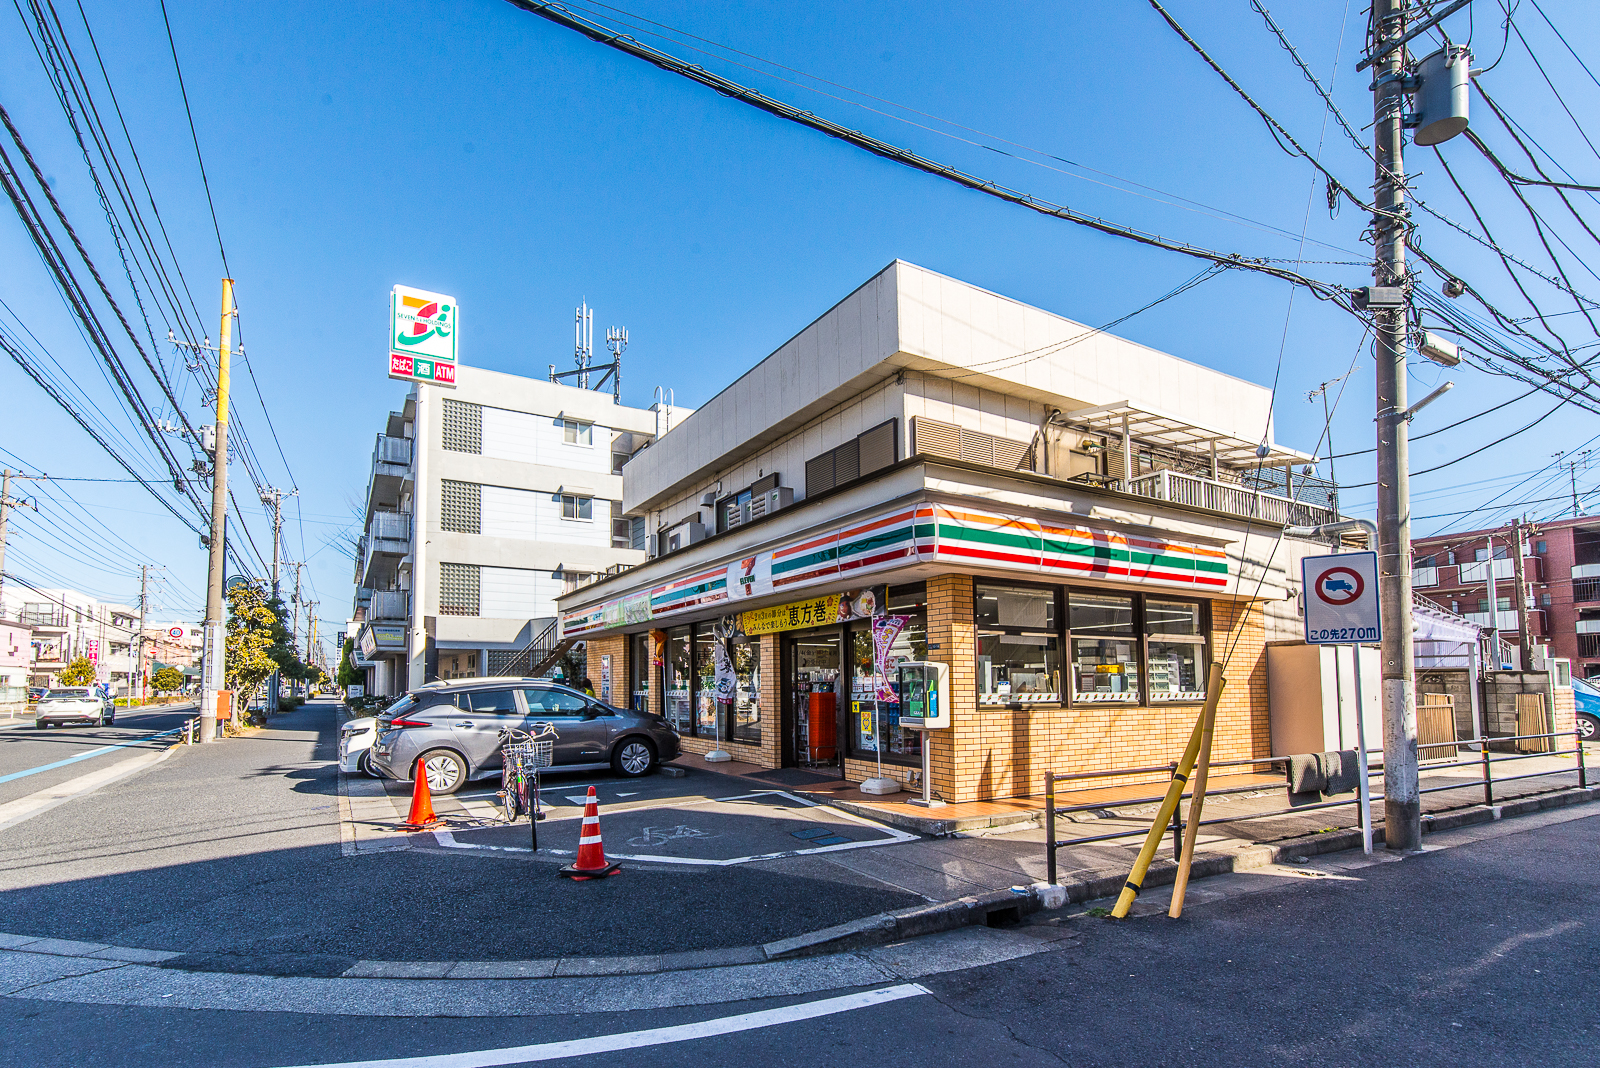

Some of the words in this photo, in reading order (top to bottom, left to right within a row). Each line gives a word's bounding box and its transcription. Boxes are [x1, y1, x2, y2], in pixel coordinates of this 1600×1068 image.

[397, 312, 416, 321] SEVEN
[423, 318, 452, 329] HOLDINGS
[392, 357, 413, 373] たばこ
[417, 362, 431, 375] 酒
[435, 365, 454, 380] ATM
[739, 575, 756, 586] ELEVEN
[788, 600, 827, 627] 恵方巻
[1310, 626, 1377, 640] この先270m
